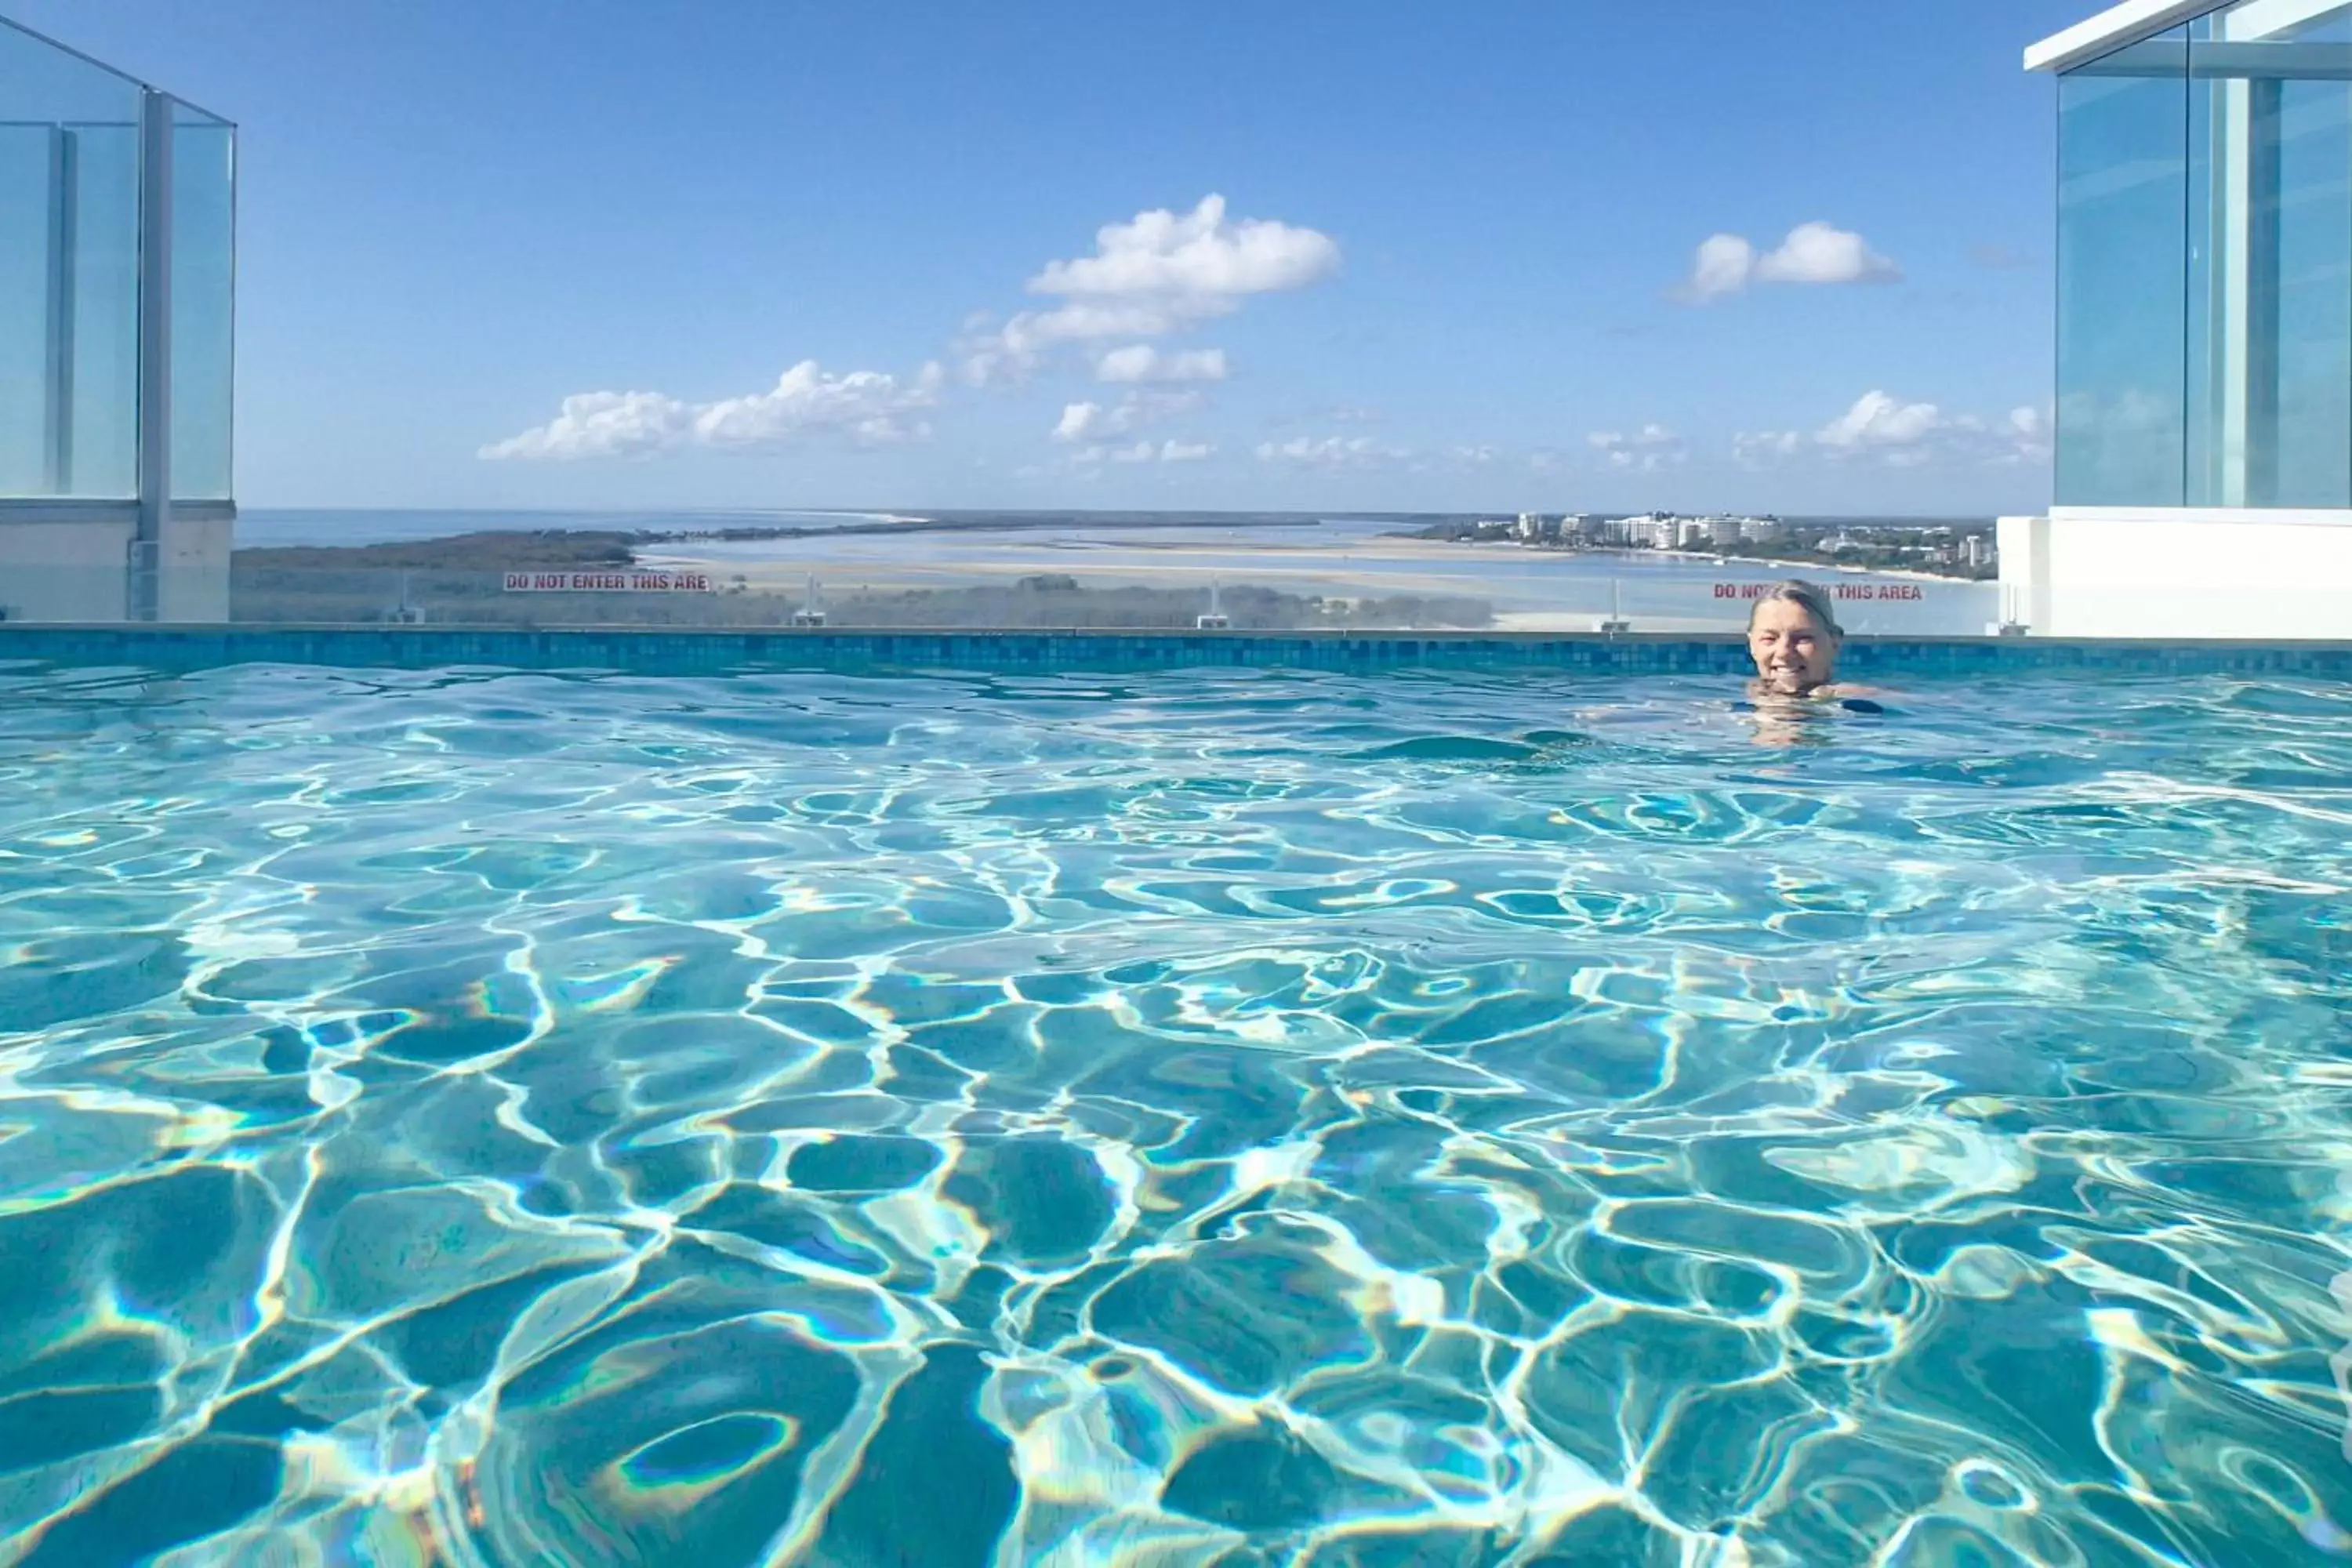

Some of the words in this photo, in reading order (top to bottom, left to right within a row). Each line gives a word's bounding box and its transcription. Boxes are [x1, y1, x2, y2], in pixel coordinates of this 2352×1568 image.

[506, 575, 528, 589] DO
[535, 575, 565, 589] NOT
[573, 575, 625, 589] ENTER
[631, 575, 669, 589] THIS
[674, 575, 706, 590] ARE
[1714, 584, 1736, 598] DO
[1742, 584, 1769, 598] NO
[1835, 584, 1873, 599] THIS
[1878, 585, 1922, 600] AREA
